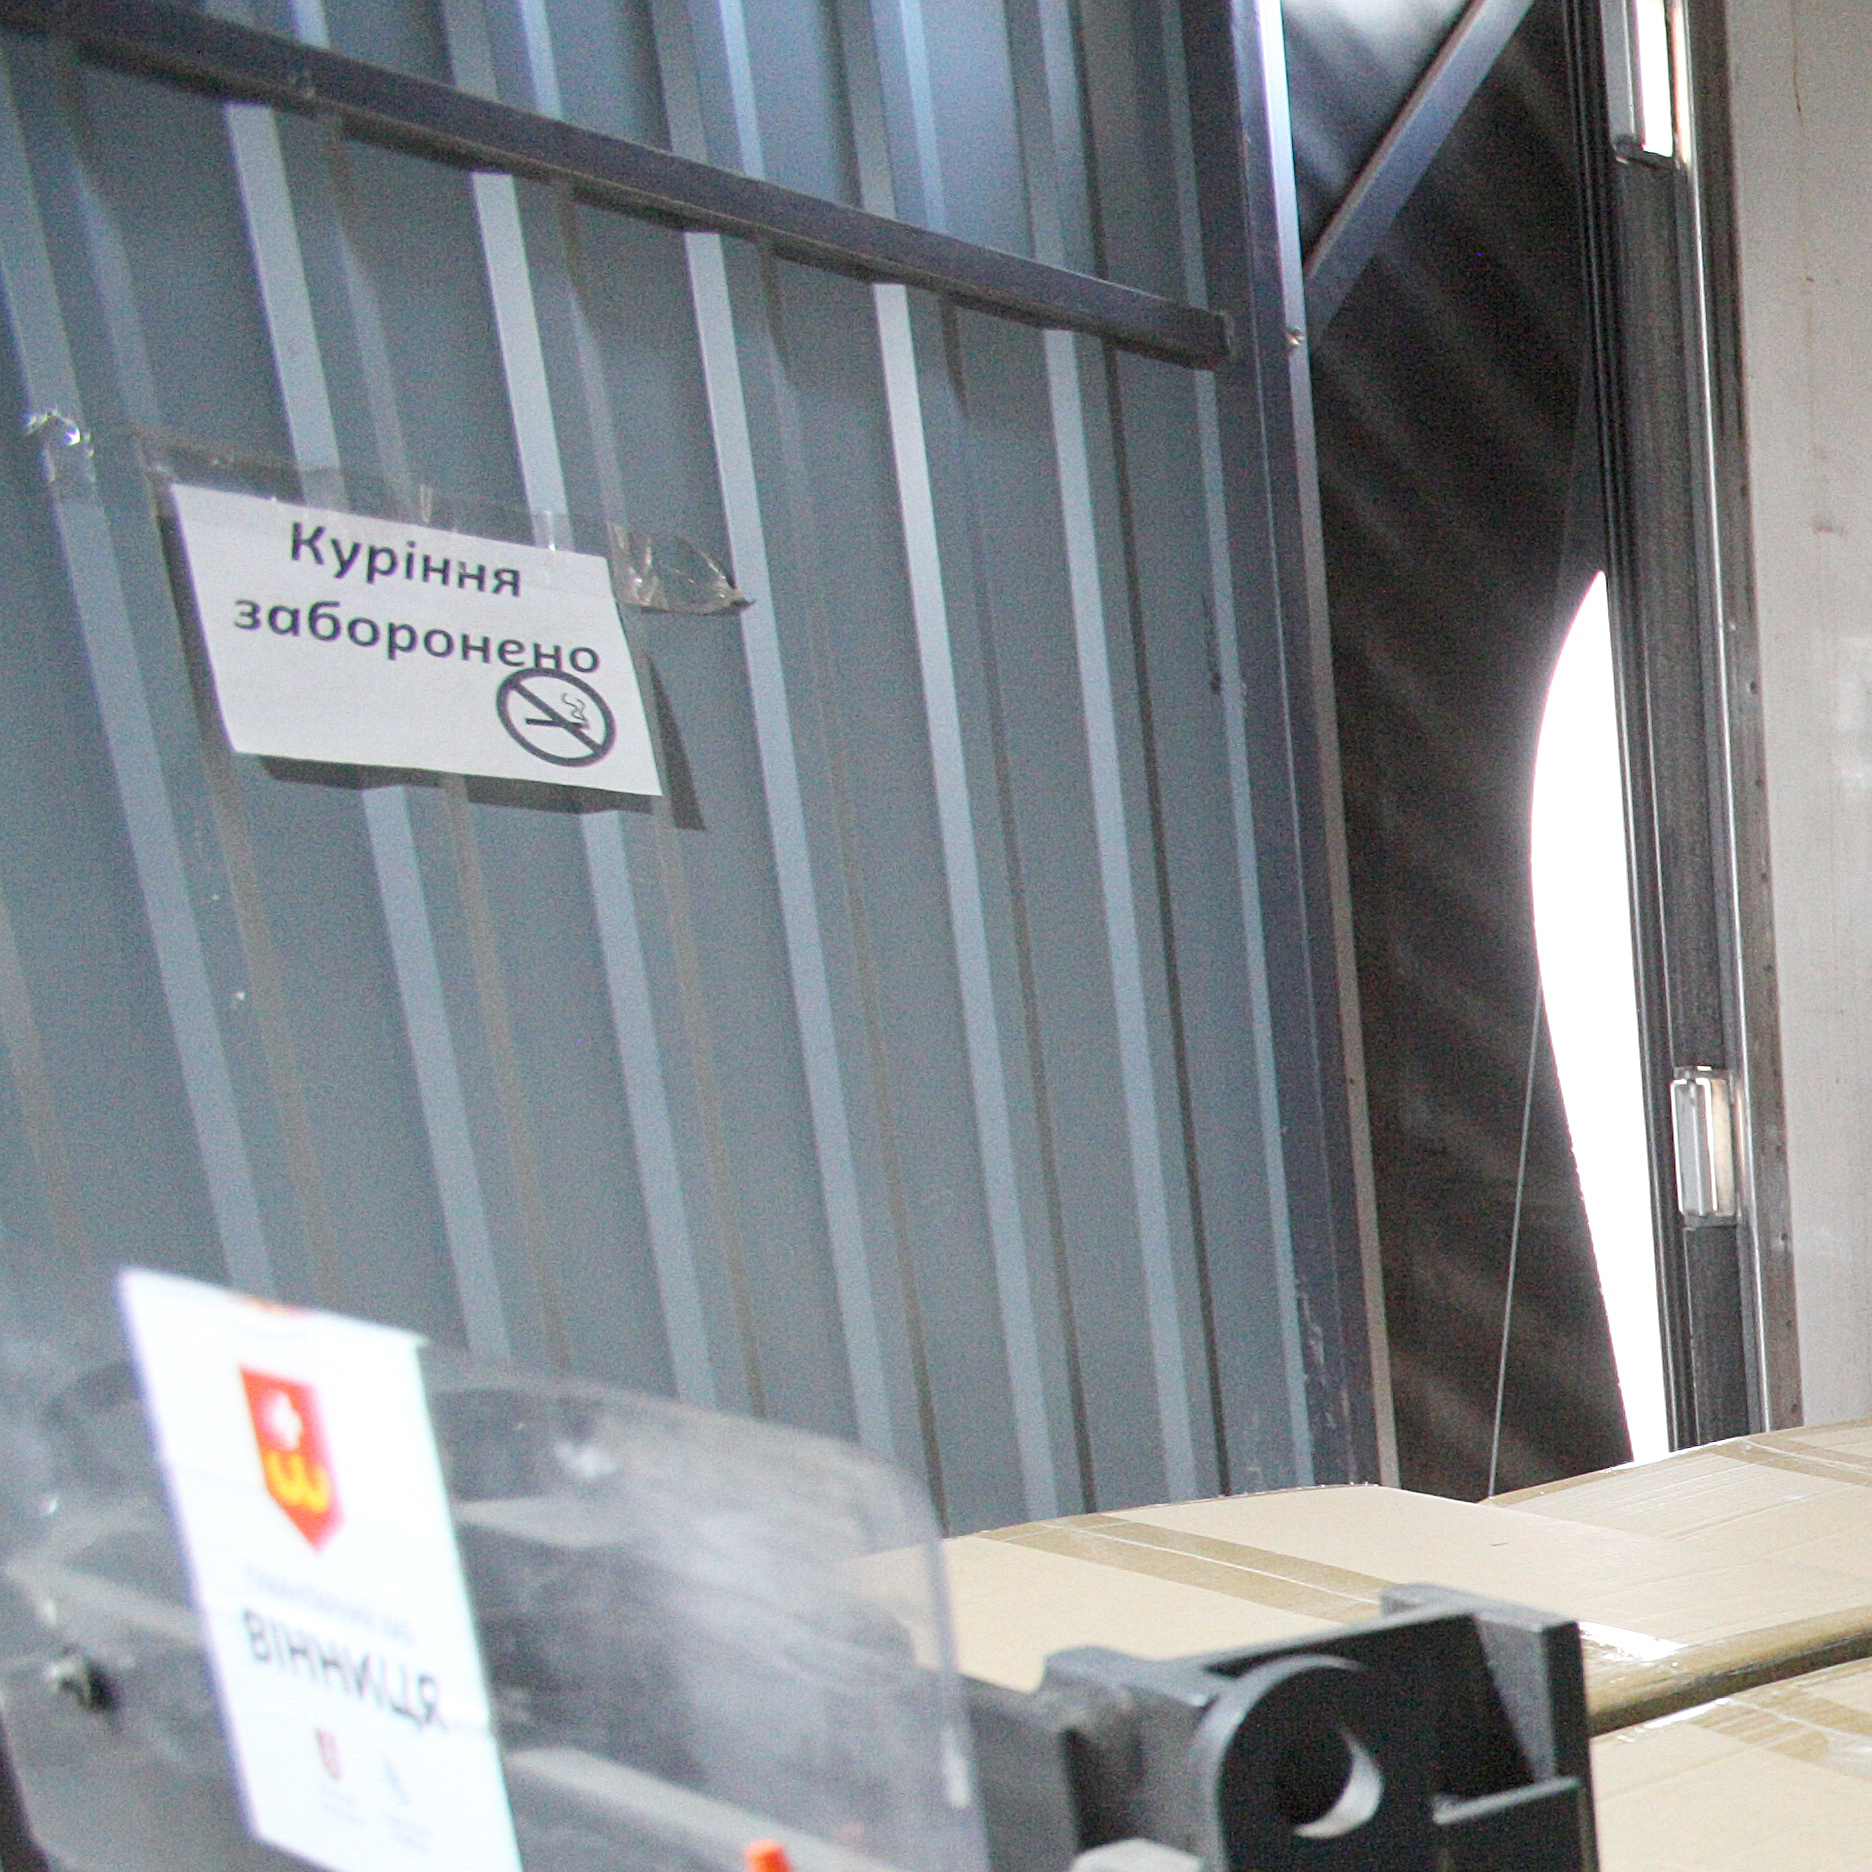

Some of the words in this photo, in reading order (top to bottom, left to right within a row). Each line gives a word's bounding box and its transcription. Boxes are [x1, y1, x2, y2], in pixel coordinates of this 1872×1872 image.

[289, 520, 523, 598] Куріння
[232, 597, 601, 675] заборонено
[243, 1606, 446, 1733] ВІННИЦЯ
